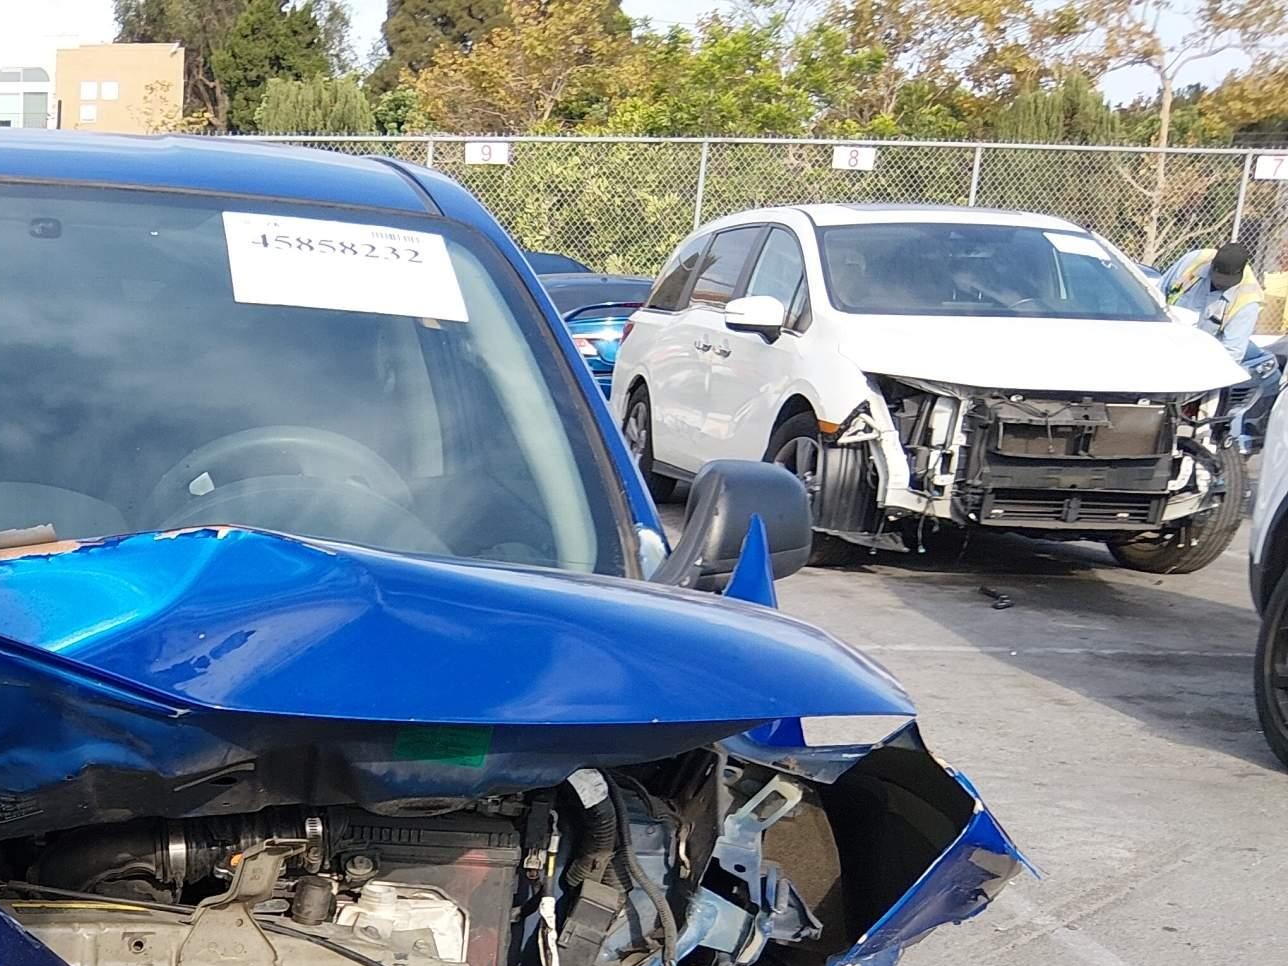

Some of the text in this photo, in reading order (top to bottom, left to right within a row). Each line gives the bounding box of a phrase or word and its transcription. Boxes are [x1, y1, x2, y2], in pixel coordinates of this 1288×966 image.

[480, 144, 492, 162] 9
[848, 149, 859, 168] 8
[1272, 158, 1285, 177] 7
[252, 232, 424, 264] 45858232
